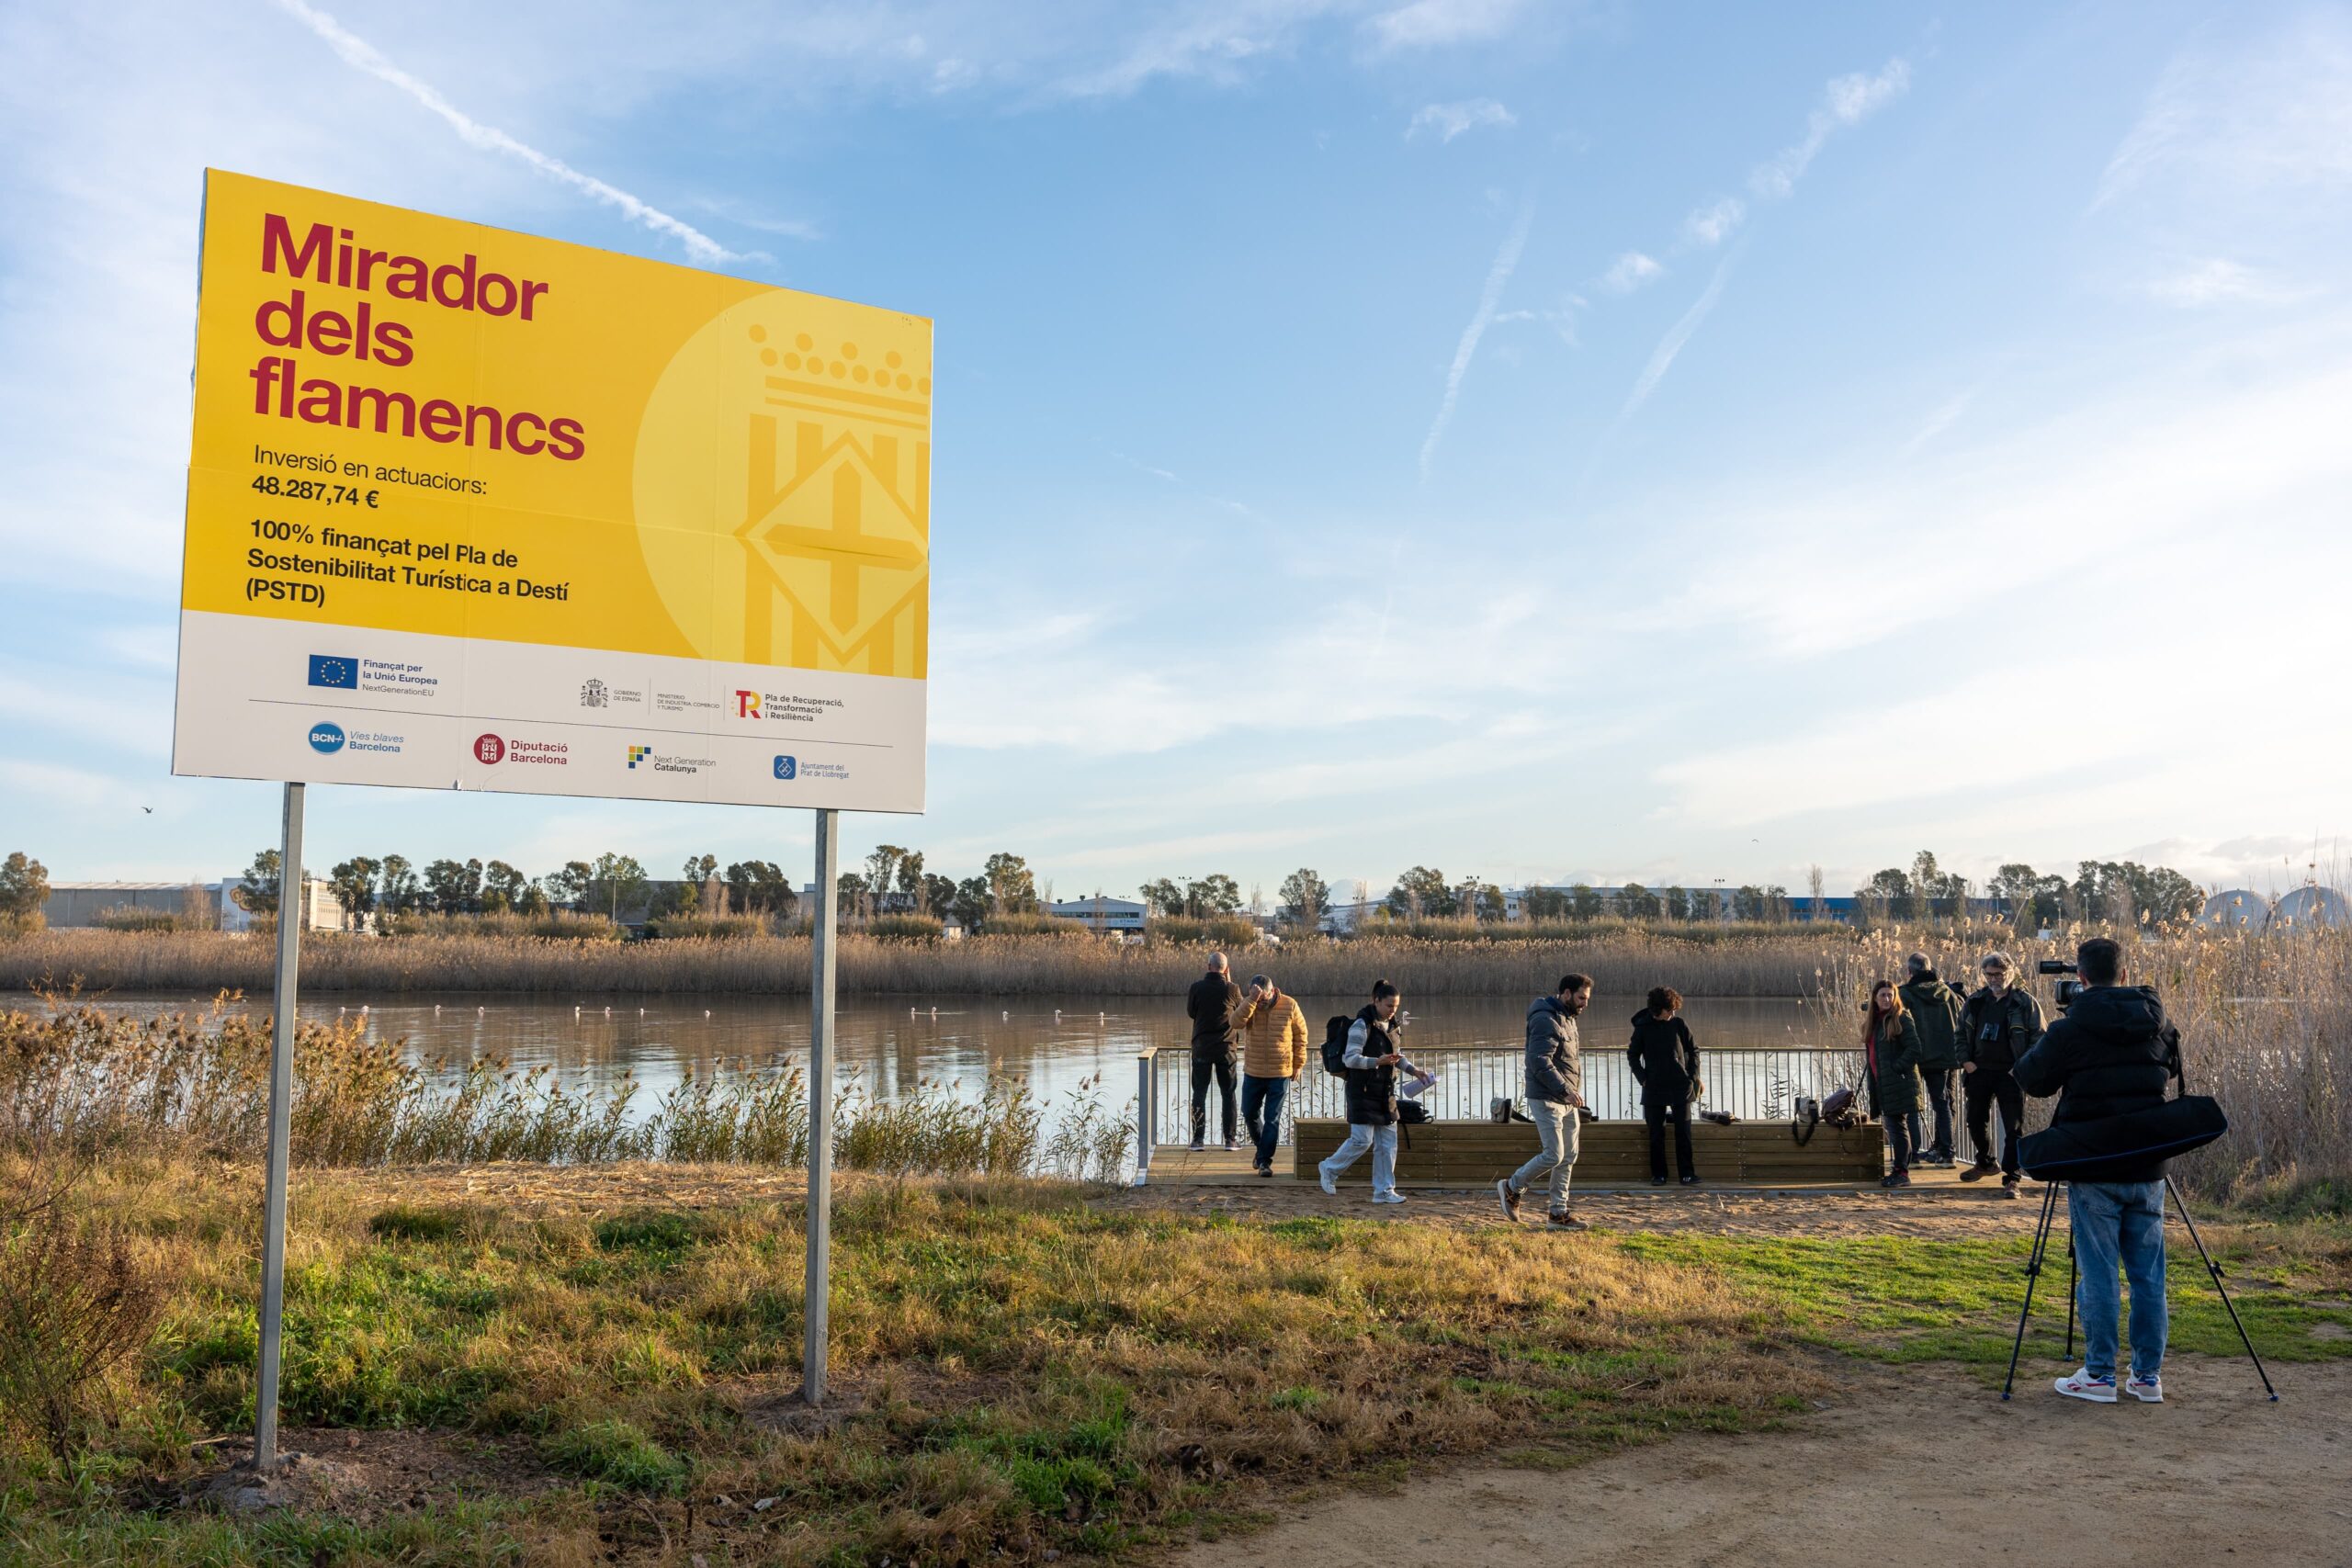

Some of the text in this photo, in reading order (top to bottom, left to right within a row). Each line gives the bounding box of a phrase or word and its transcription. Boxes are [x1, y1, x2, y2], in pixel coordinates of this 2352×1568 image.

[261, 212, 549, 321] Mirador
[254, 289, 414, 367] dels
[249, 355, 586, 461] flamencs
[254, 445, 337, 474] Inversió
[343, 461, 368, 479] en
[252, 475, 379, 508] 48.287,74 €
[251, 519, 518, 569] 100% finançat pel Pla de
[247, 548, 570, 602] Sostenibilitat Turística a Destí
[246, 578, 325, 608] (PSTD)
[363, 659, 423, 673] Finançat per
[363, 671, 438, 686] la Unió Europea
[362, 683, 435, 696] NextGenerationEU
[764, 694, 844, 708] Pla de Recuperació,
[764, 703, 823, 714] Transformació
[770, 713, 814, 722] Resiliència
[350, 730, 404, 743] Vies blaves
[349, 741, 401, 752] Barcelona
[511, 739, 568, 753] Diputació
[510, 752, 568, 764] Barcelona
[654, 755, 716, 767] Next Generation
[654, 763, 696, 773] Catalunya
[800, 762, 834, 771] Ajuntament
[822, 771, 850, 779] Llobregat
